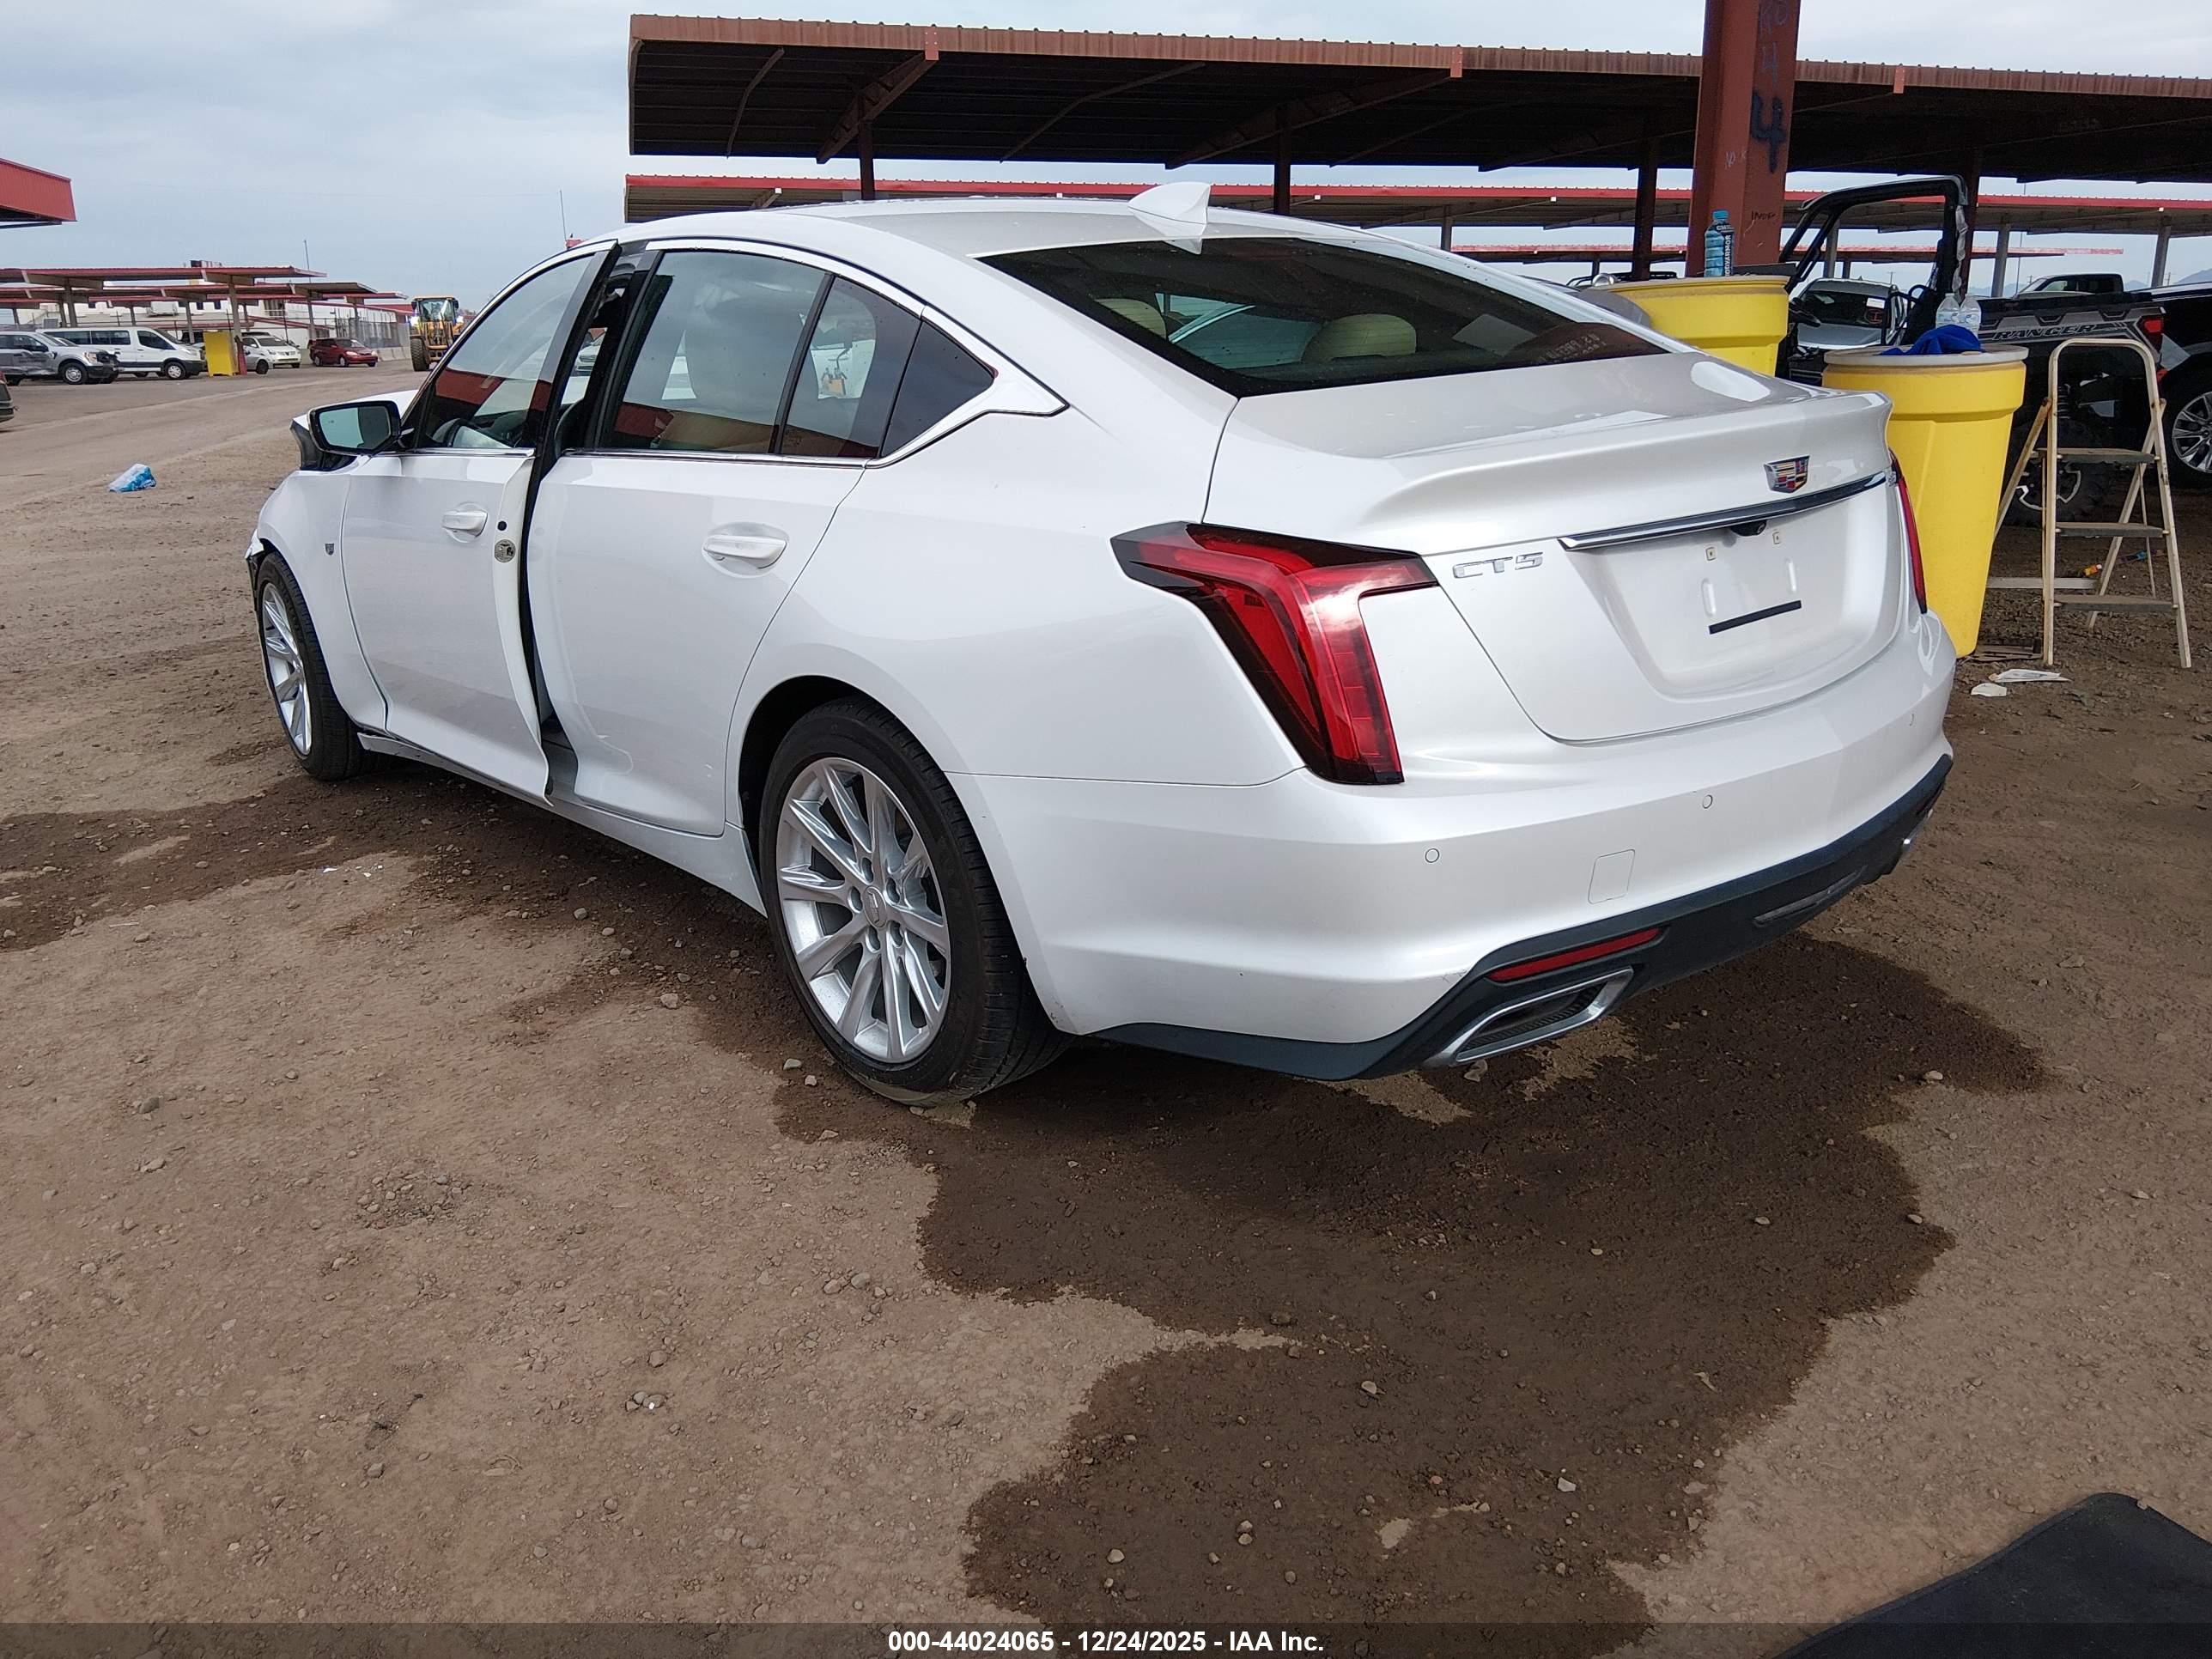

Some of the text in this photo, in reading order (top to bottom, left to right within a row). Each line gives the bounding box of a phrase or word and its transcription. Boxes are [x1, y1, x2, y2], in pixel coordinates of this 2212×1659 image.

[1751, 89, 1787, 173] 4
[1992, 323, 2097, 341] RANGER
[1452, 551, 1543, 579] CT5
